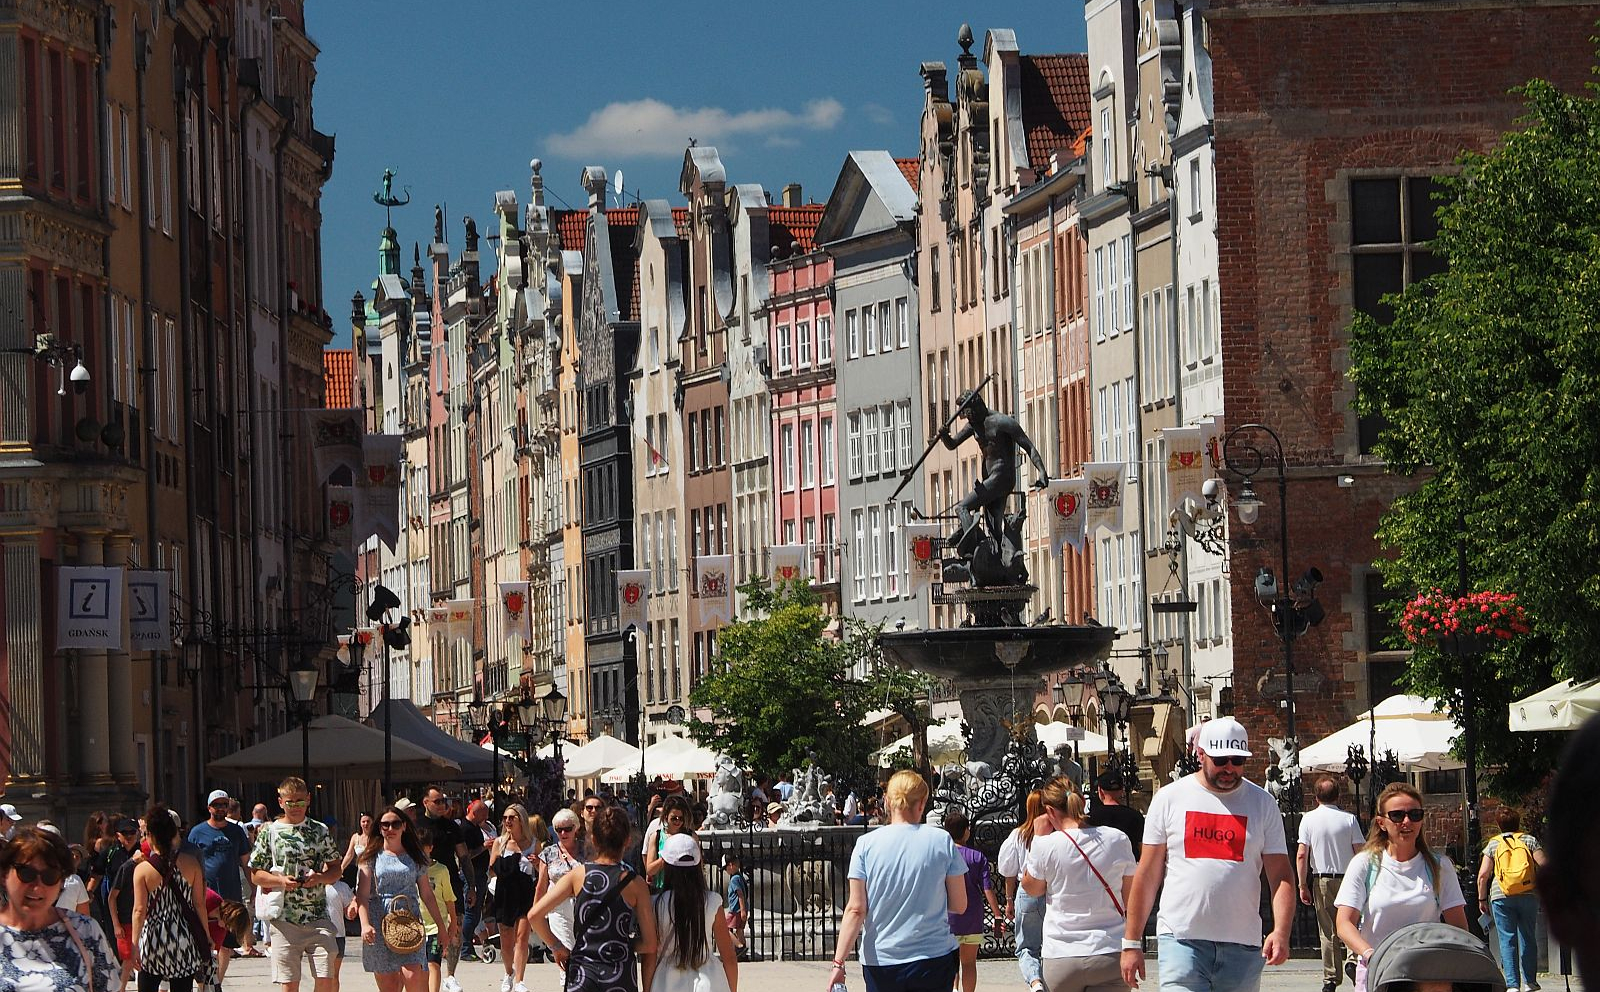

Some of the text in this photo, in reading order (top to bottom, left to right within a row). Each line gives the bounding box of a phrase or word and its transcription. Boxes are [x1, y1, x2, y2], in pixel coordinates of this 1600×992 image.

[68, 627, 109, 638] GDAŃSK
[1209, 739, 1247, 752] HUGO
[1193, 826, 1235, 842] HUGO
